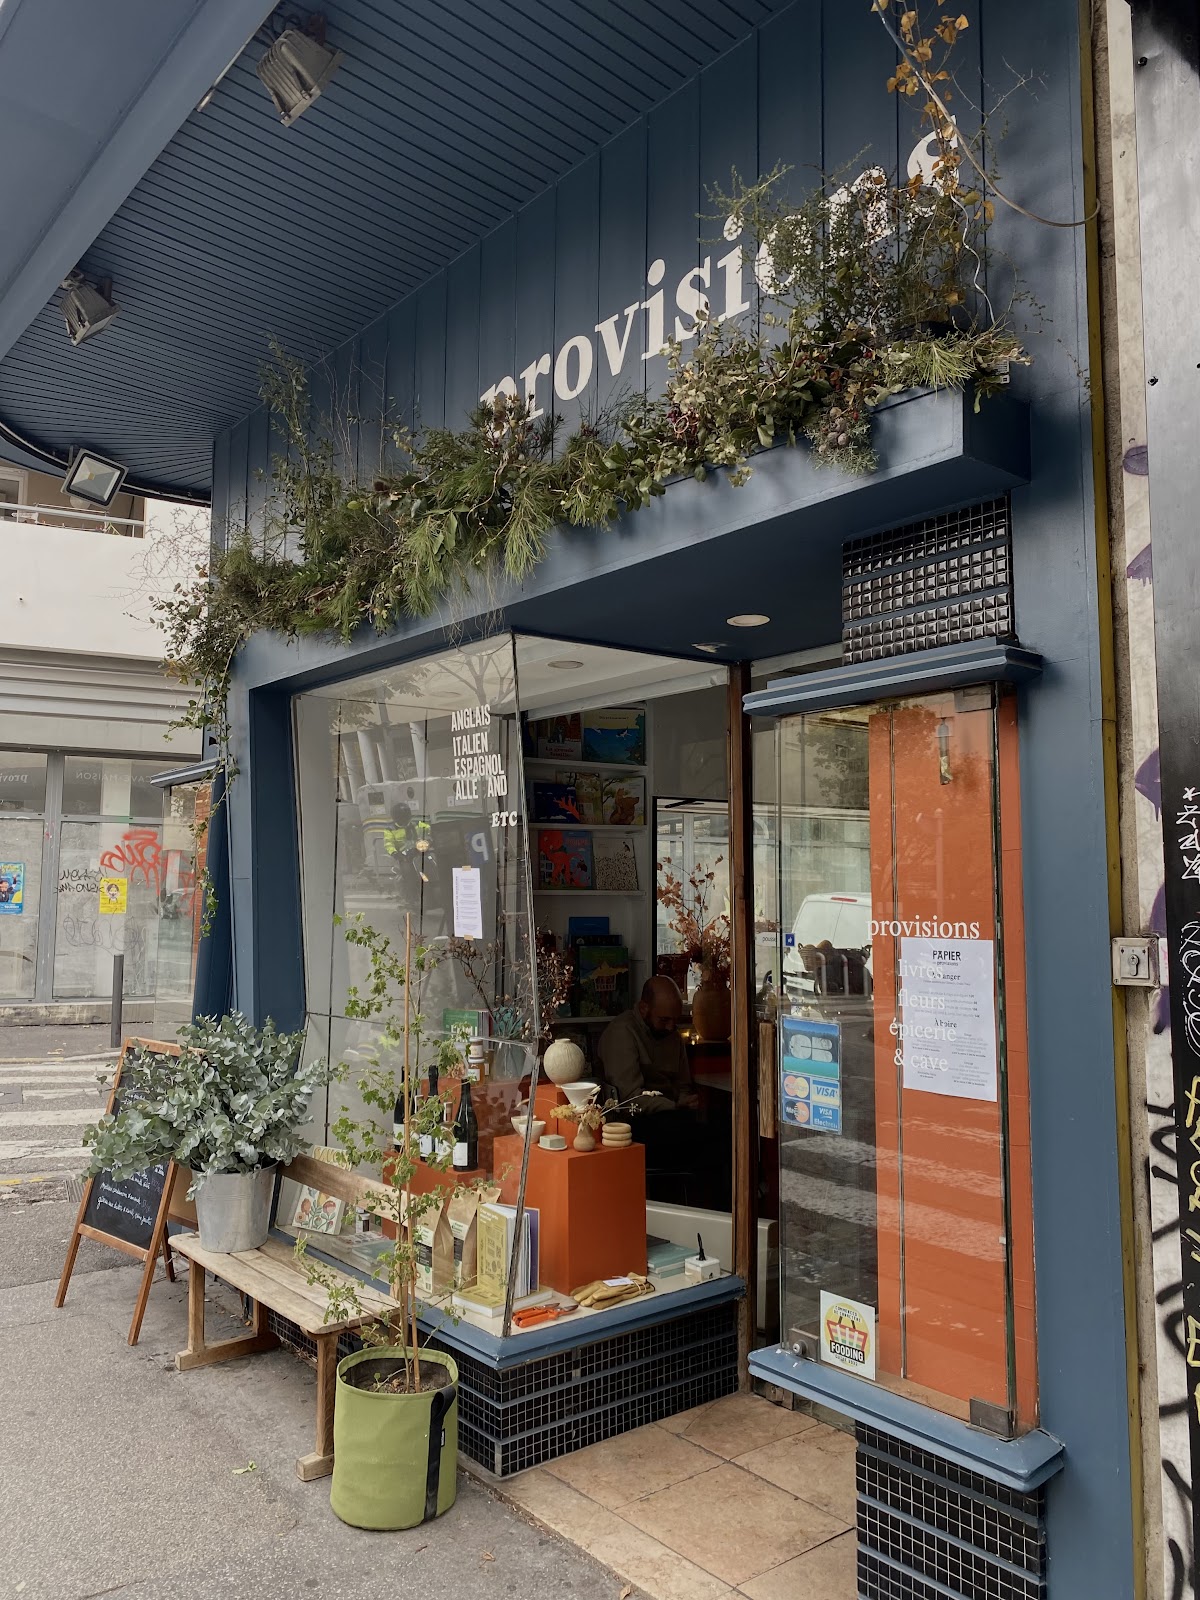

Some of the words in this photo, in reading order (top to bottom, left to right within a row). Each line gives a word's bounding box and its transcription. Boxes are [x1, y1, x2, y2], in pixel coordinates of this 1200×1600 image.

[451, 703, 491, 732] ANGLAIS
[453, 732, 489, 757] ITALIEN
[454, 754, 505, 779] ESPAGNOL
[491, 810, 518, 828] ETC
[866, 914, 980, 941] provisions
[932, 950, 962, 962] PAPIER
[897, 958, 943, 979] livres
[898, 988, 946, 1010] fleurs
[889, 1017, 958, 1042] épicerie
[894, 1048, 905, 1066] &
[910, 1054, 950, 1073] cave
[816, 1086, 836, 1098] VISA
[831, 1341, 864, 1362] FOODING
